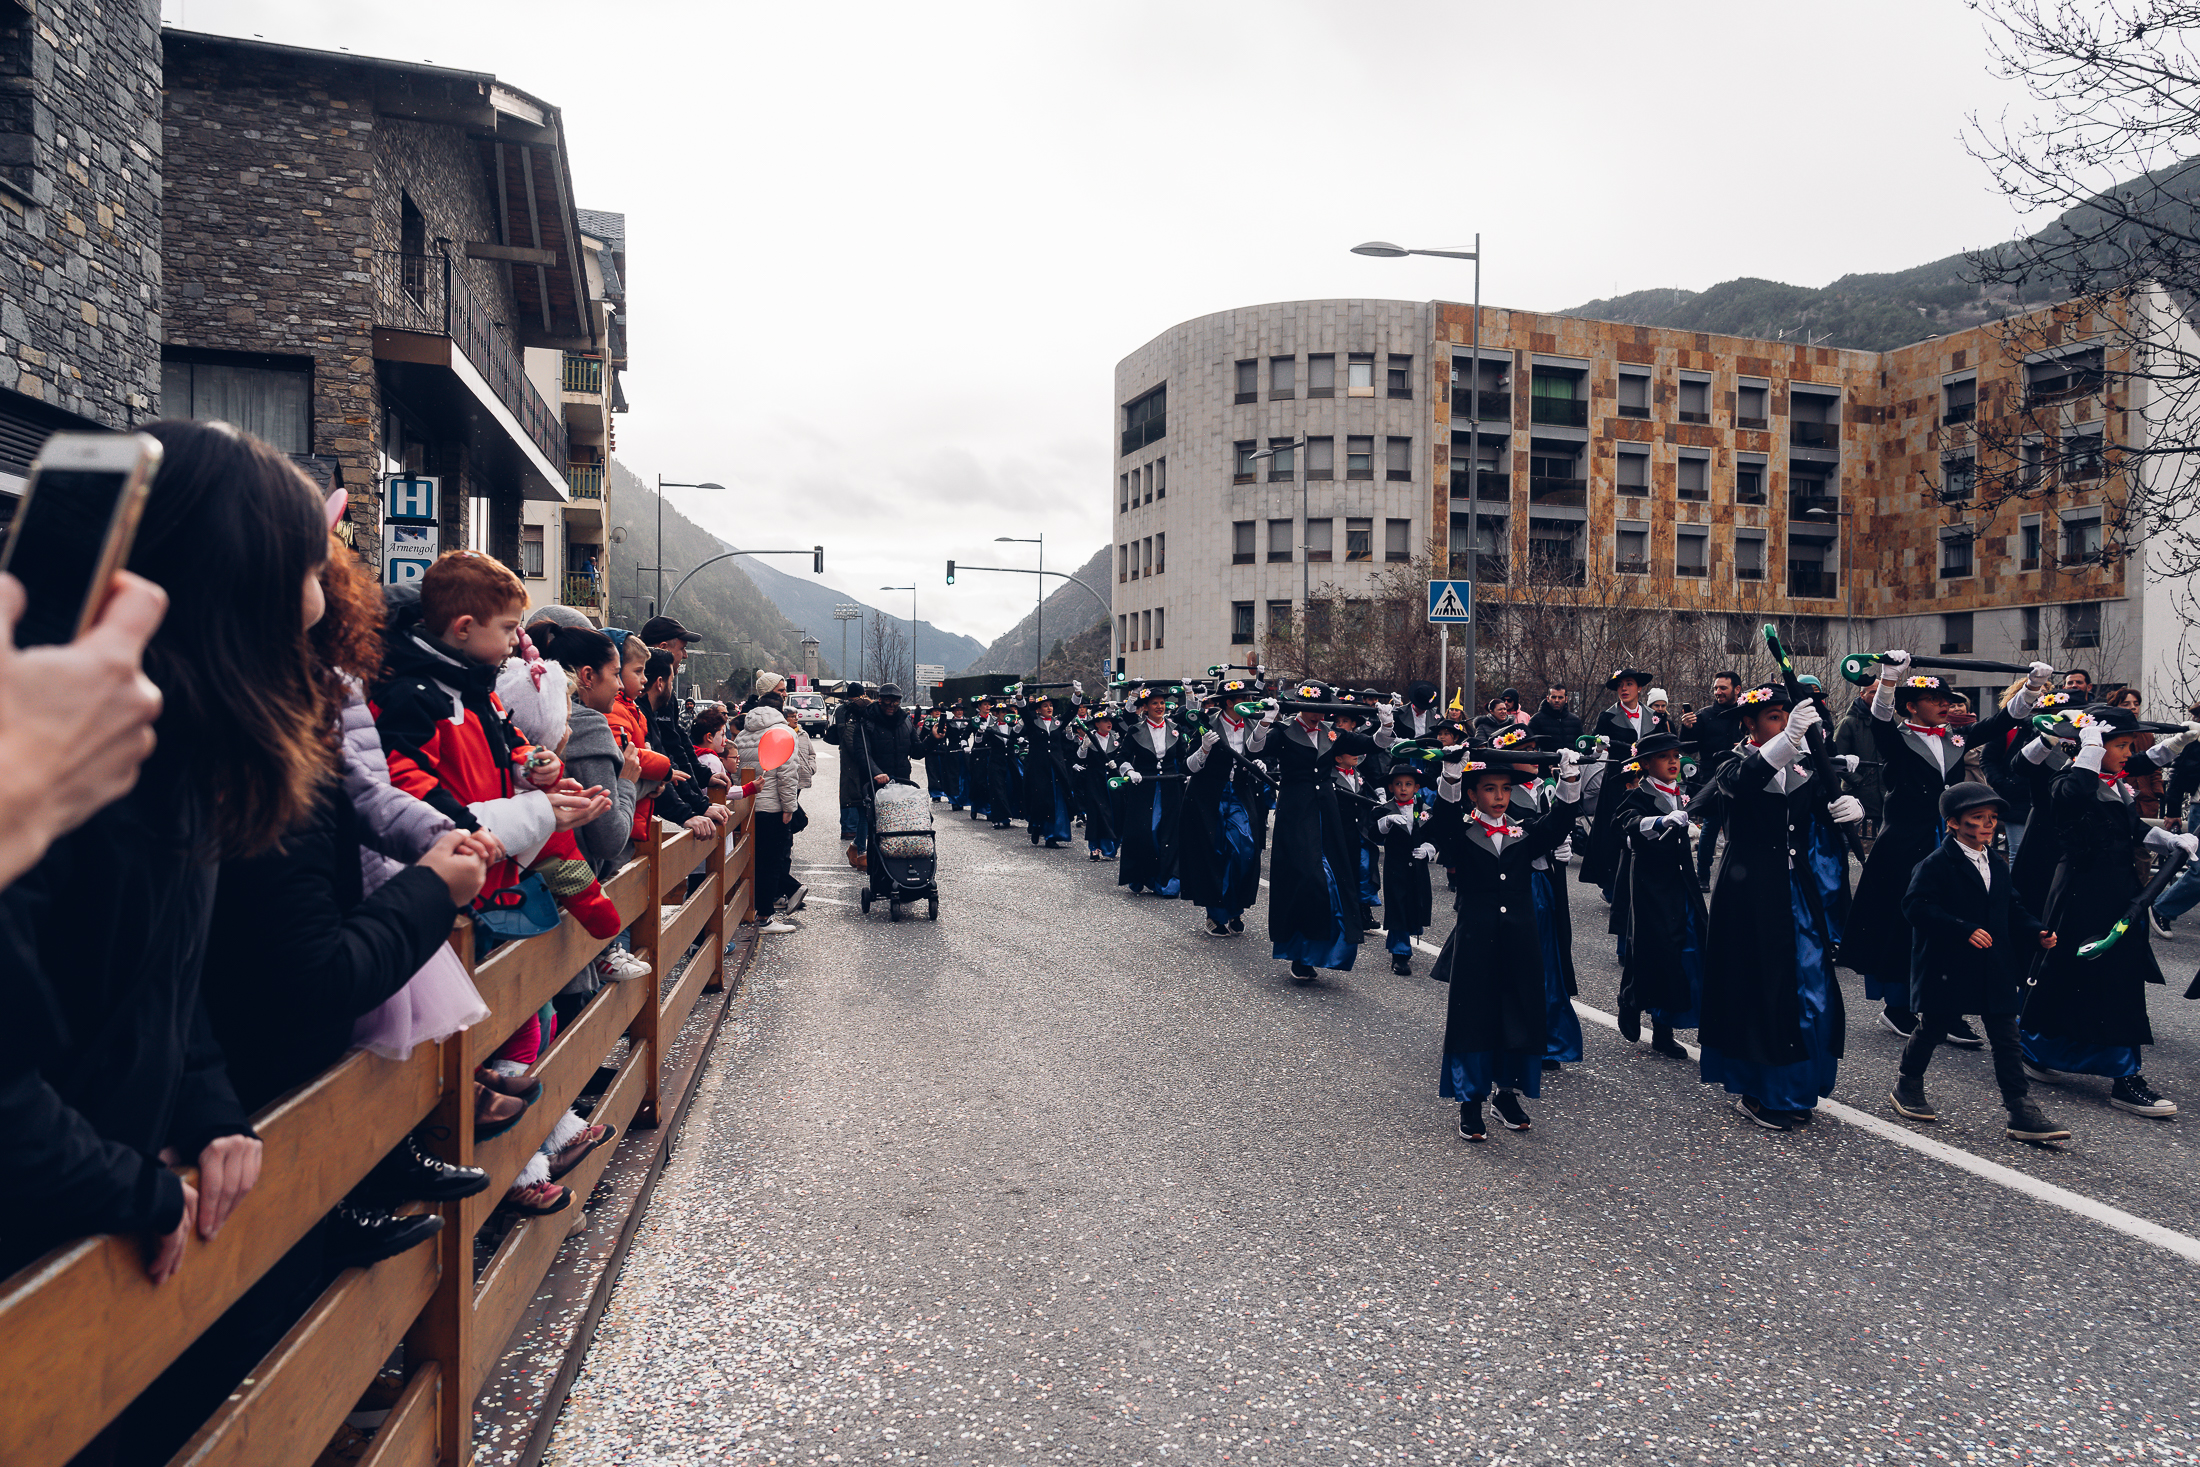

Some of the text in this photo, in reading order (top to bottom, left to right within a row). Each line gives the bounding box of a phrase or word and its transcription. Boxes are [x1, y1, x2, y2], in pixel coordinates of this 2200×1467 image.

[396, 482, 427, 516] H
[386, 542, 436, 556] Armengol
[396, 561, 425, 583] P
